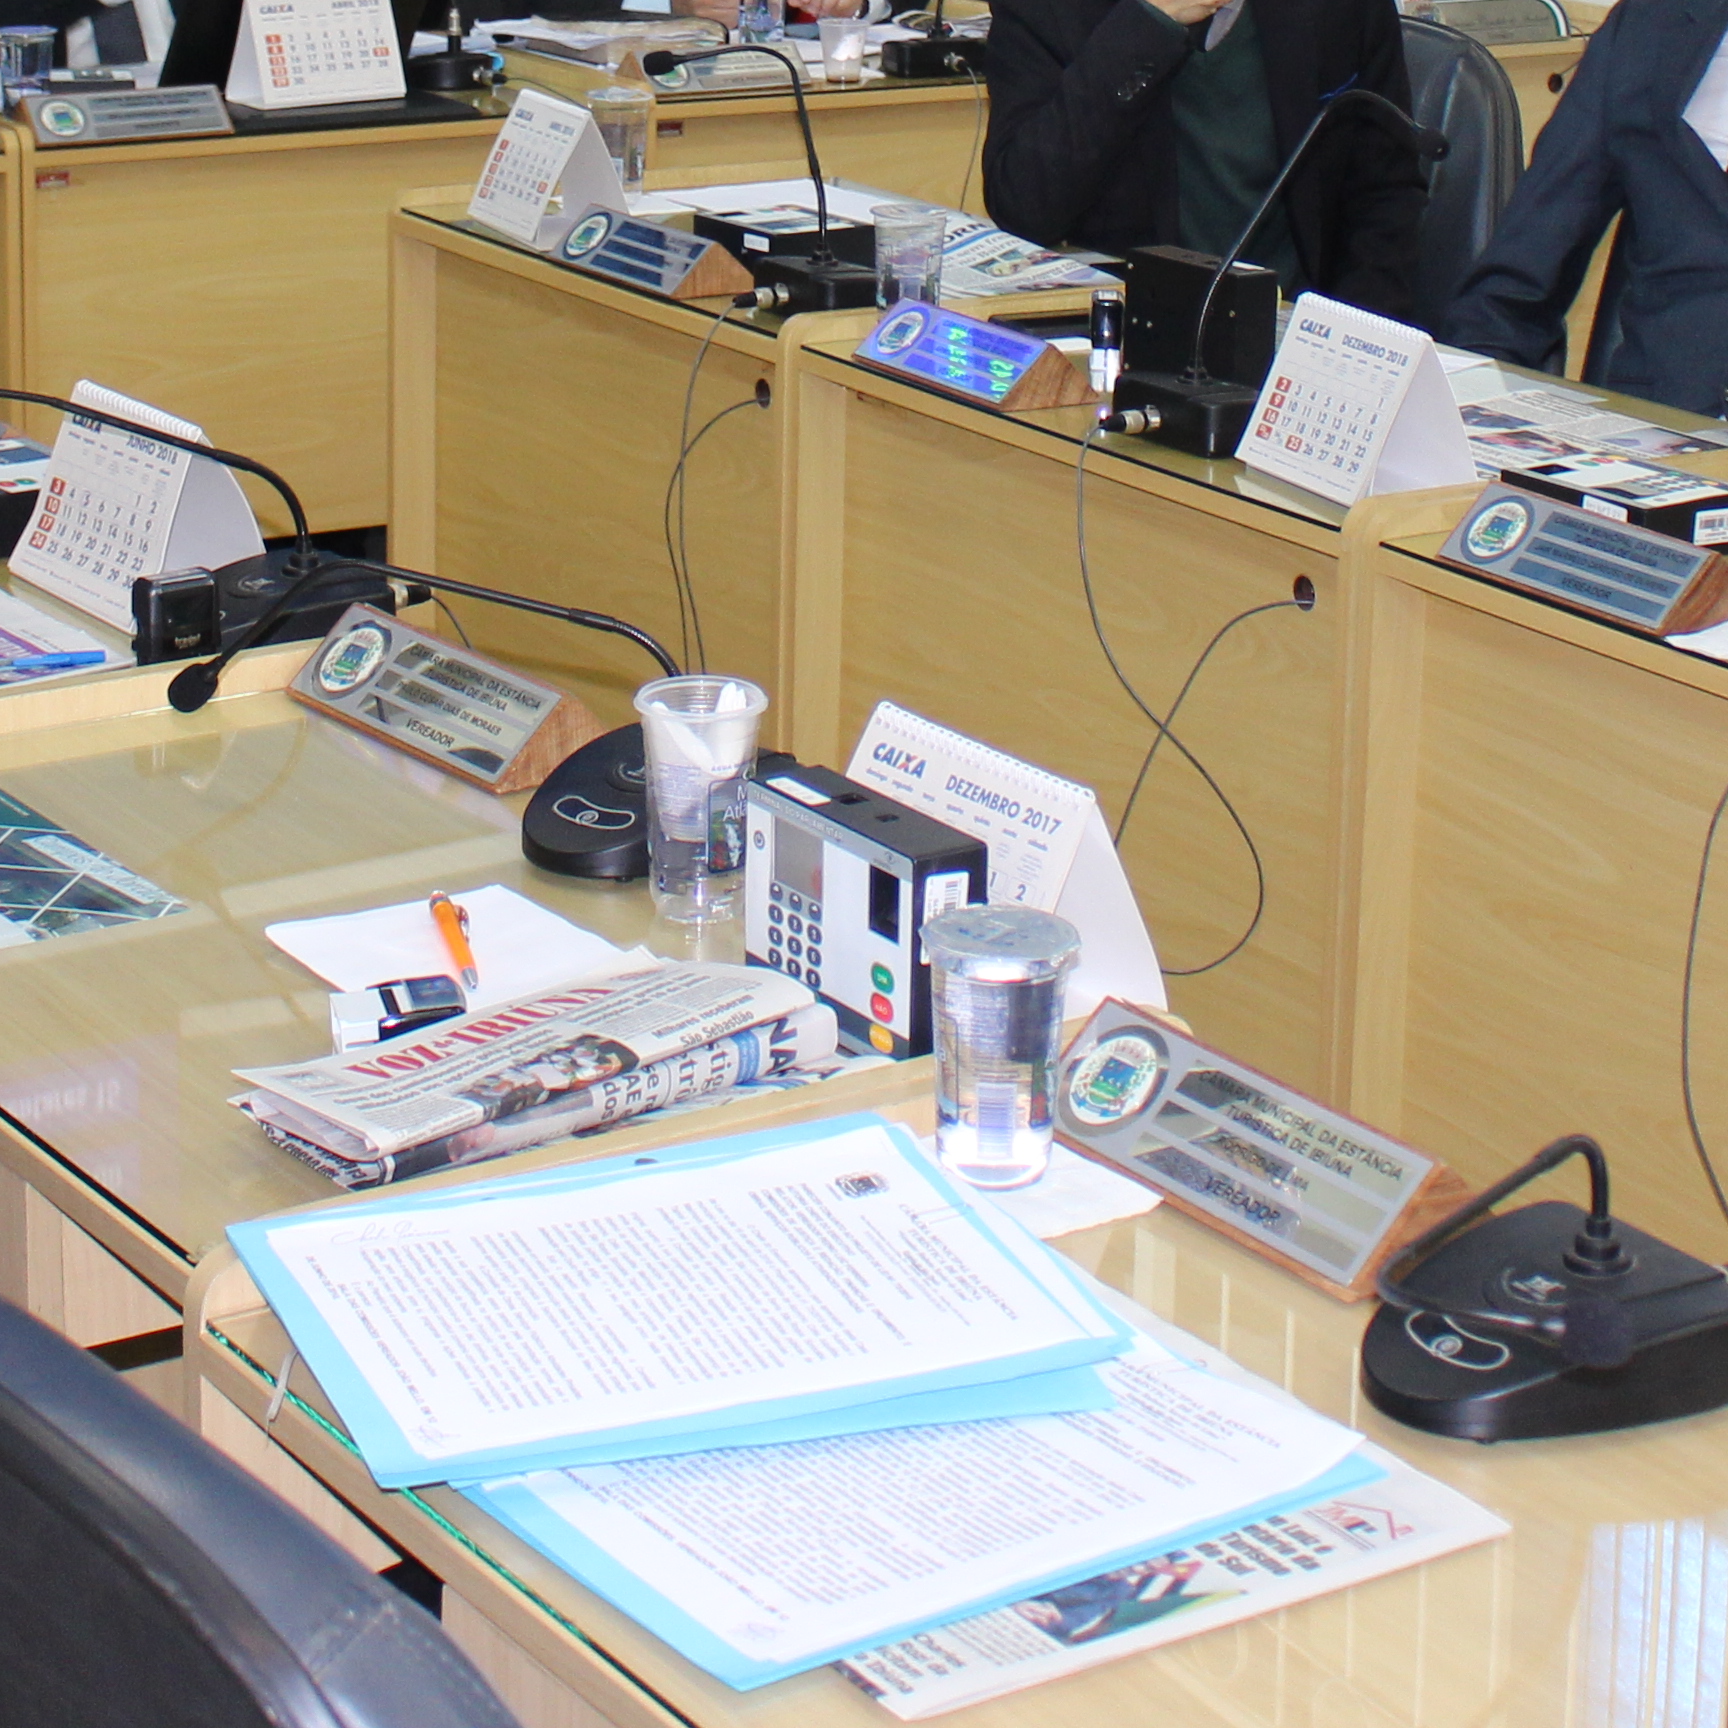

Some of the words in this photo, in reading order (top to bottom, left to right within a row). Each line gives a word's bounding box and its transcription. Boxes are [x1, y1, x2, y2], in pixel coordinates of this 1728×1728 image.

[260, 5, 294, 15] CAIXA
[1300, 318, 1332, 339] CAIXA
[1342, 334, 1386, 358] DEZEMBRO
[1386, 346, 1408, 366] 2018
[126, 435, 155, 455] JUNHO
[158, 446, 178, 465] 2018
[466, 687, 480, 700] DE
[486, 678, 499, 690] DA
[406, 718, 455, 748] VEREADOR
[873, 742, 927, 779] CAIXA
[945, 774, 1021, 818] DEZEMBRO
[1022, 807, 1063, 835] 2017
[990, 872, 997, 888] 1
[1015, 884, 1026, 901] 2
[651, 1017, 698, 1039] Milhares
[700, 993, 754, 1019] receberam
[680, 1035, 702, 1049] São
[702, 1010, 754, 1038] Sebastião
[343, 1044, 454, 1080] VOZ
[1253, 1095, 1315, 1138] MUNICIPAL
[1318, 1129, 1337, 1147] DA
[1289, 1137, 1309, 1155] DE
[1205, 1175, 1281, 1222] VEREADOR
